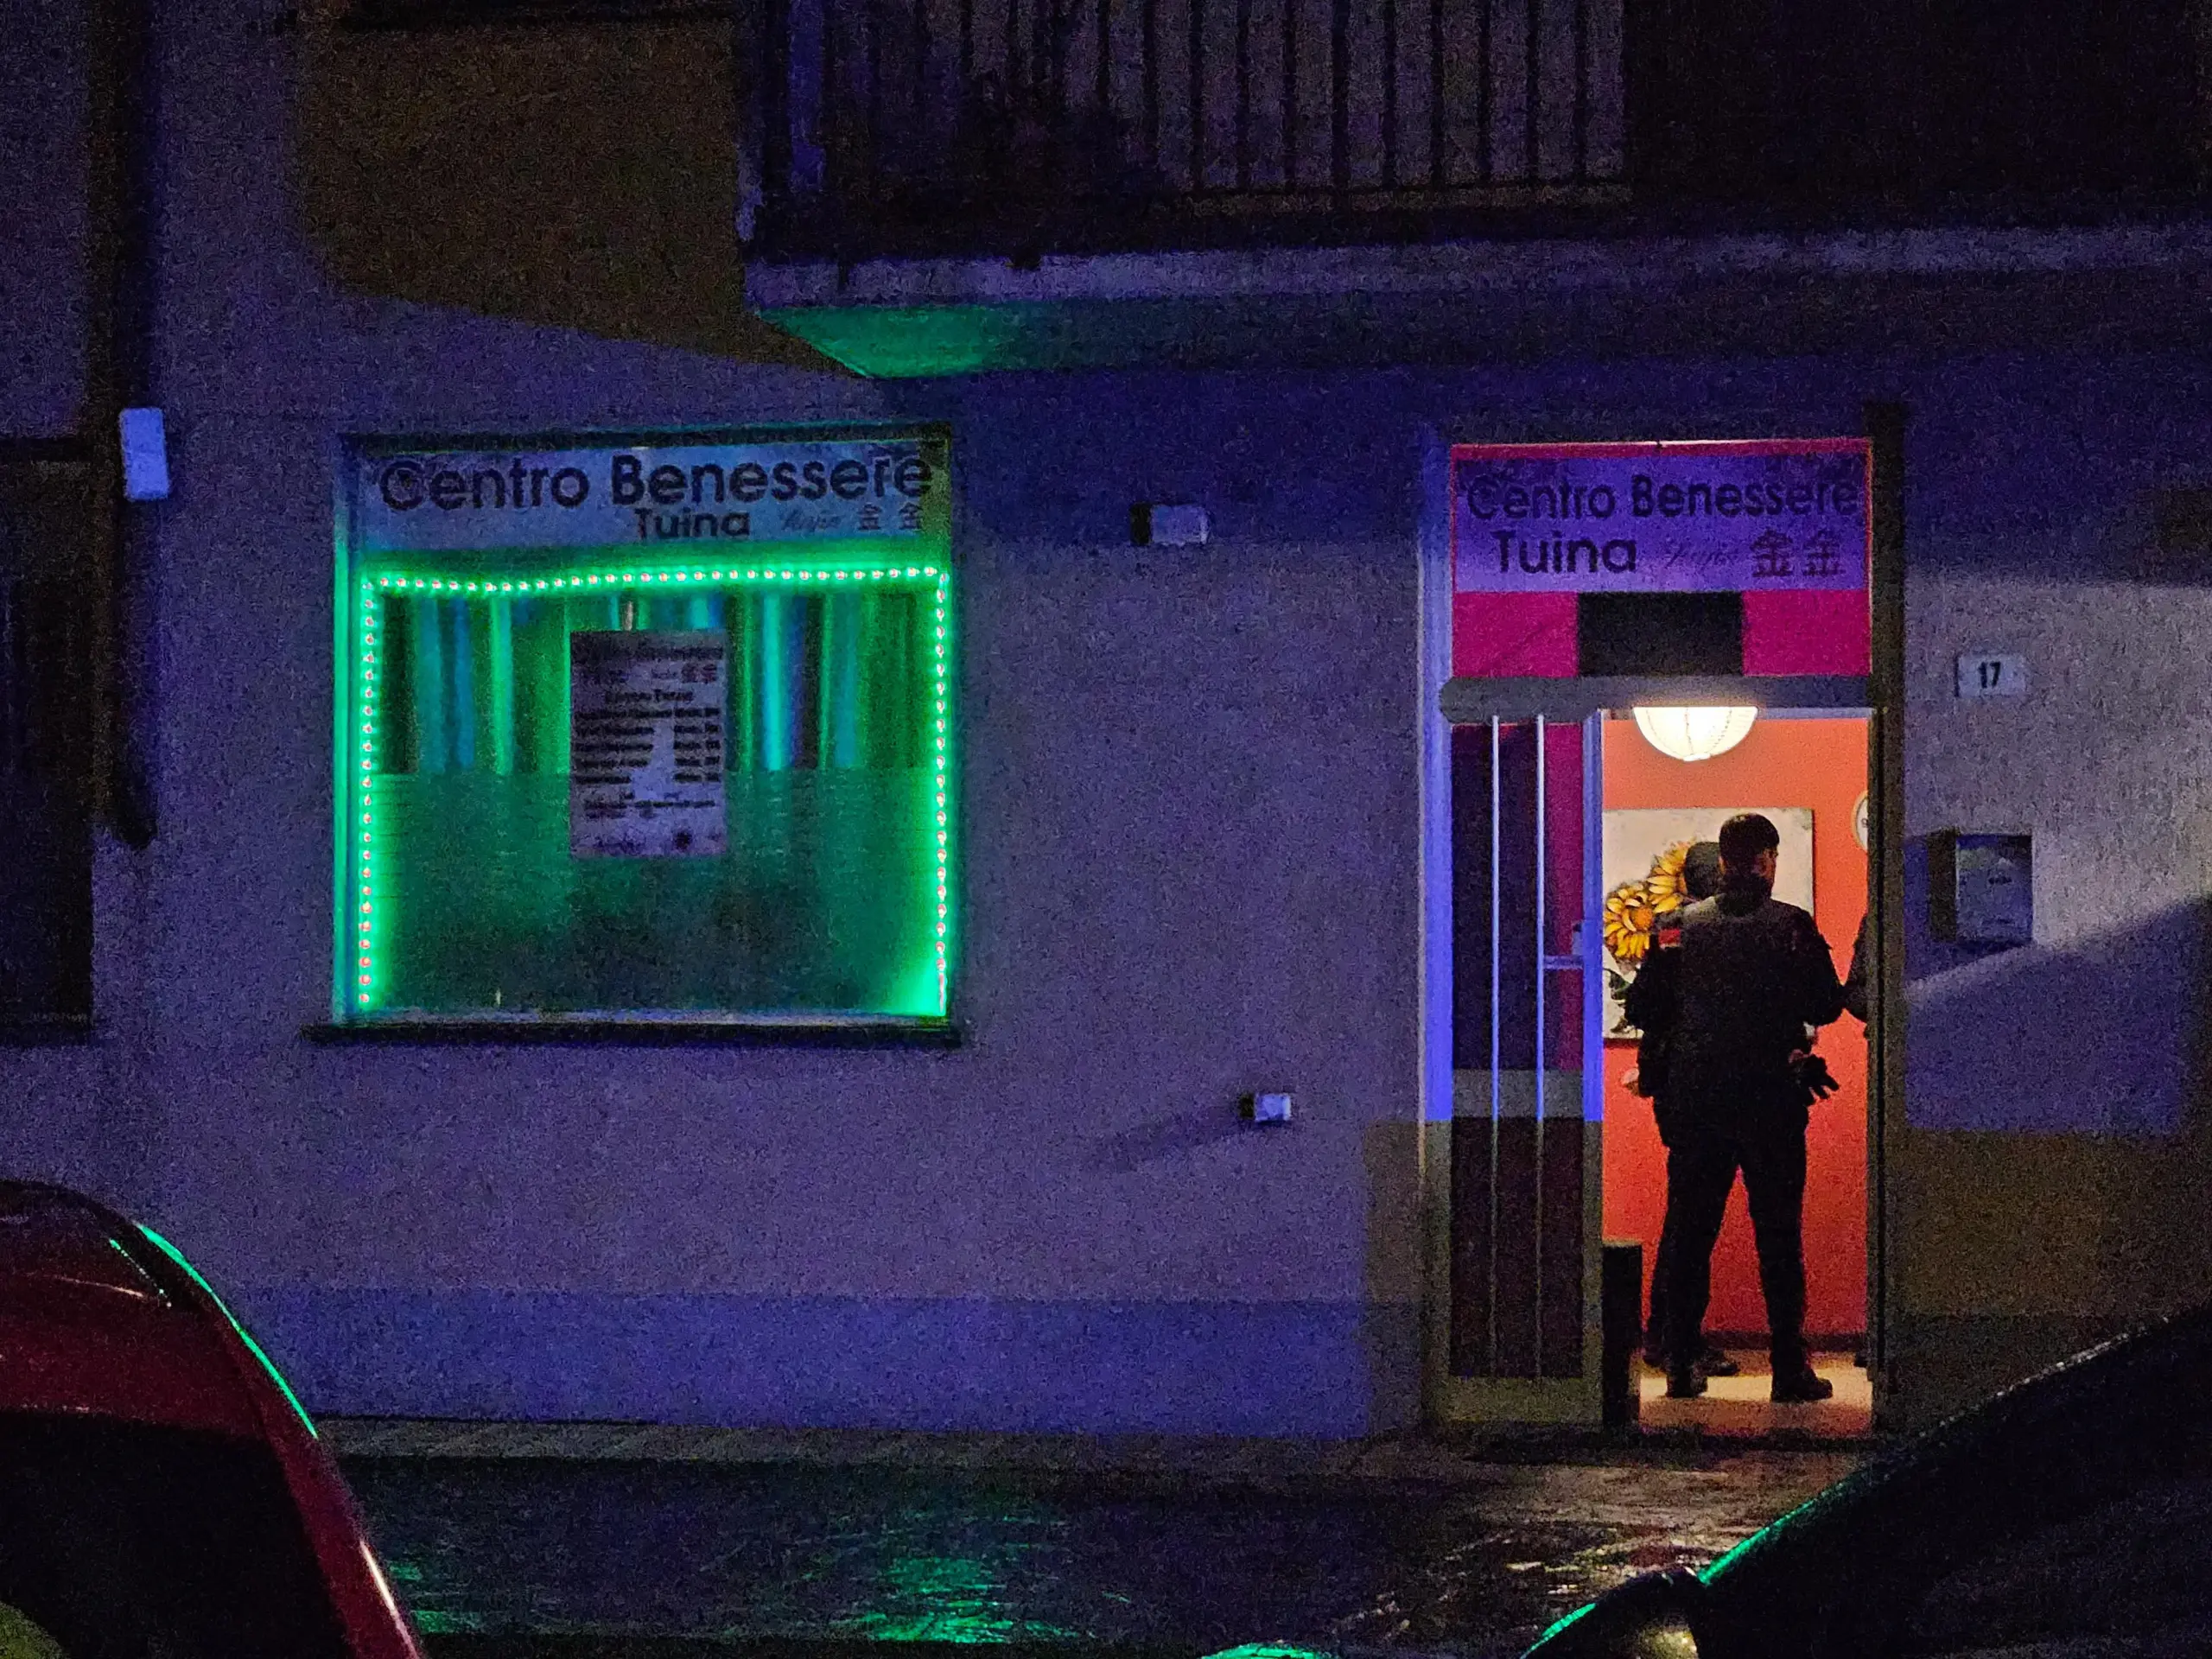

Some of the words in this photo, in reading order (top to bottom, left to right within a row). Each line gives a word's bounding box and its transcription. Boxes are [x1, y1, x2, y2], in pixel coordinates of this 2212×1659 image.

[379, 459, 589, 510] Centro
[610, 454, 932, 506] Benessere
[1469, 474, 1616, 521] Centro
[1631, 474, 1859, 518] Benessere
[634, 506, 751, 539] Tuina
[1490, 529, 1637, 574] Tuina
[1978, 661, 2001, 688] 17
